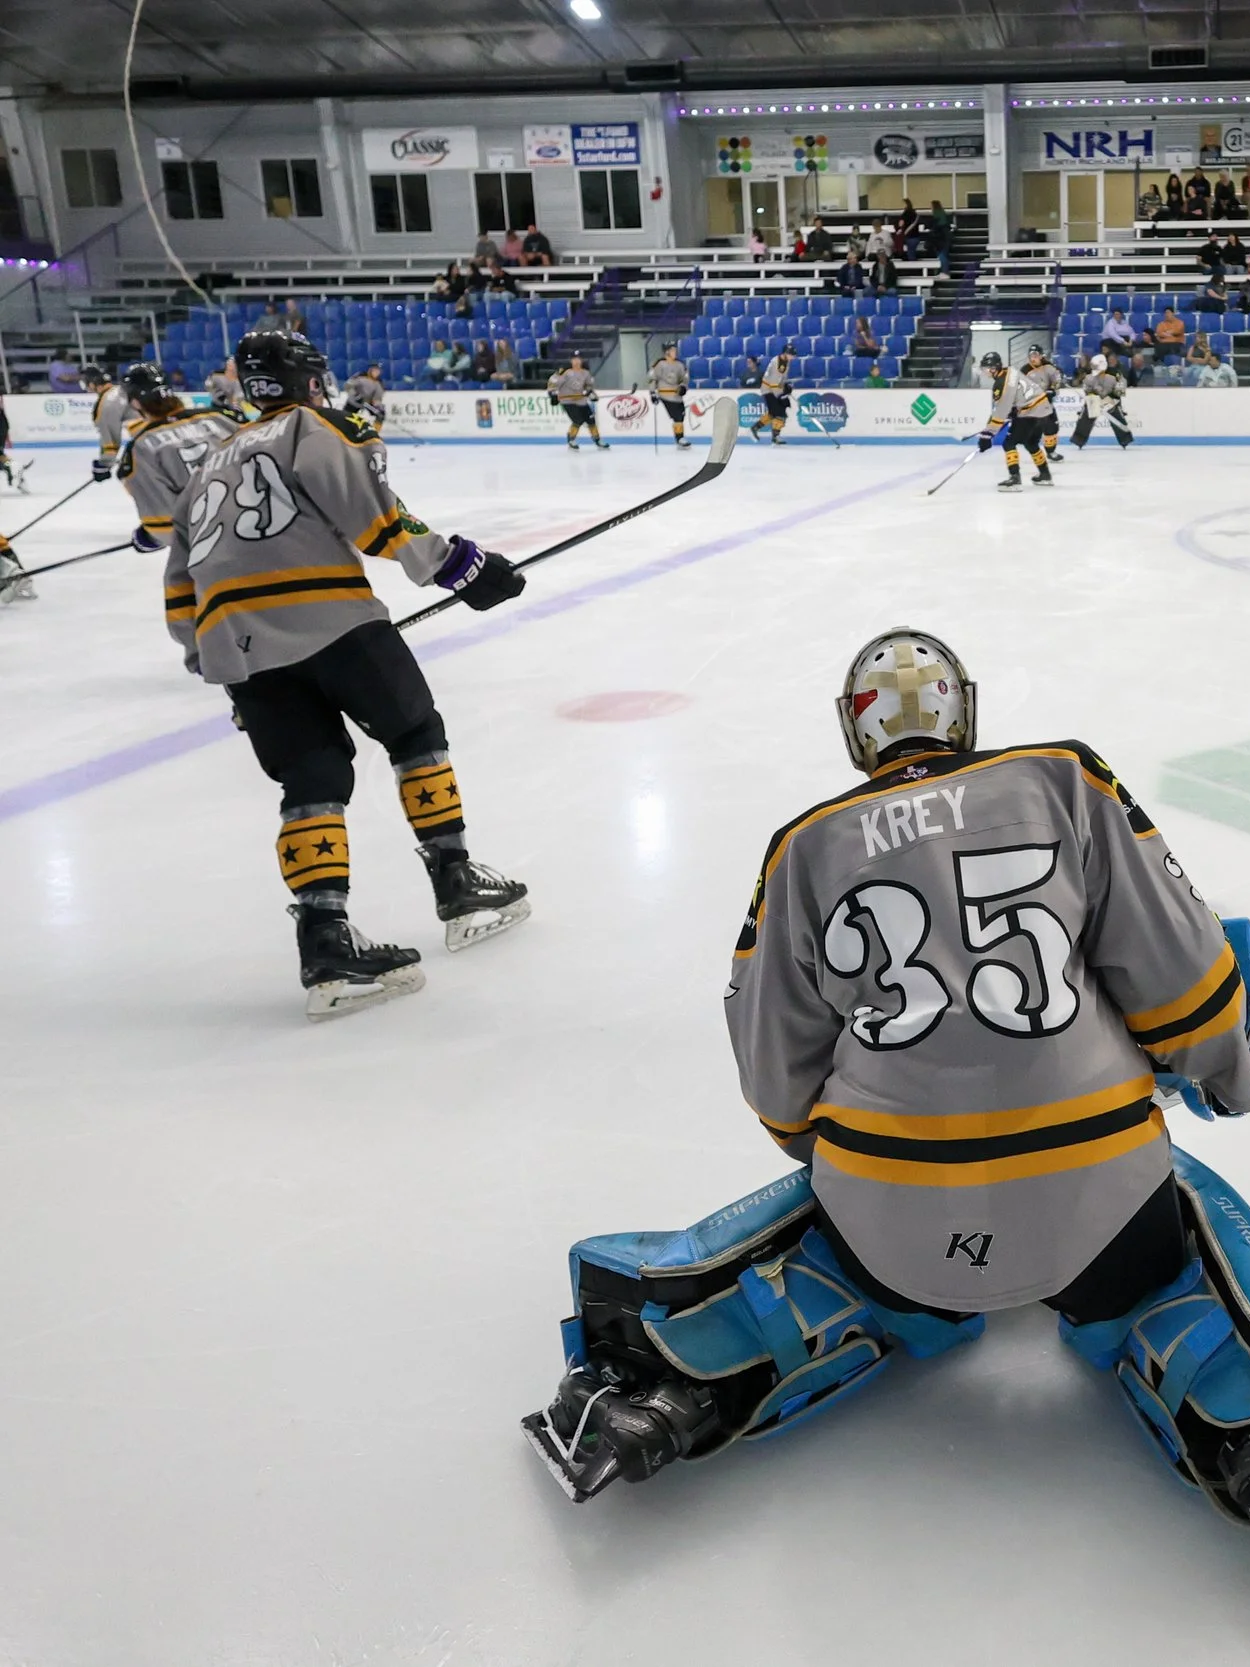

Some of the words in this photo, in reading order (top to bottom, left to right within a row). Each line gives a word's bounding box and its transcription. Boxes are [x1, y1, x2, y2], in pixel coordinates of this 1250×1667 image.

[1043, 129, 1153, 158] NRH
[405, 402, 456, 416] GLAZE
[874, 416, 913, 425] SPRING
[937, 416, 976, 424] VALLEY
[187, 452, 301, 568] 29
[859, 785, 967, 859] KREY
[823, 840, 1080, 1052] 35
[944, 1230, 994, 1274] K1
